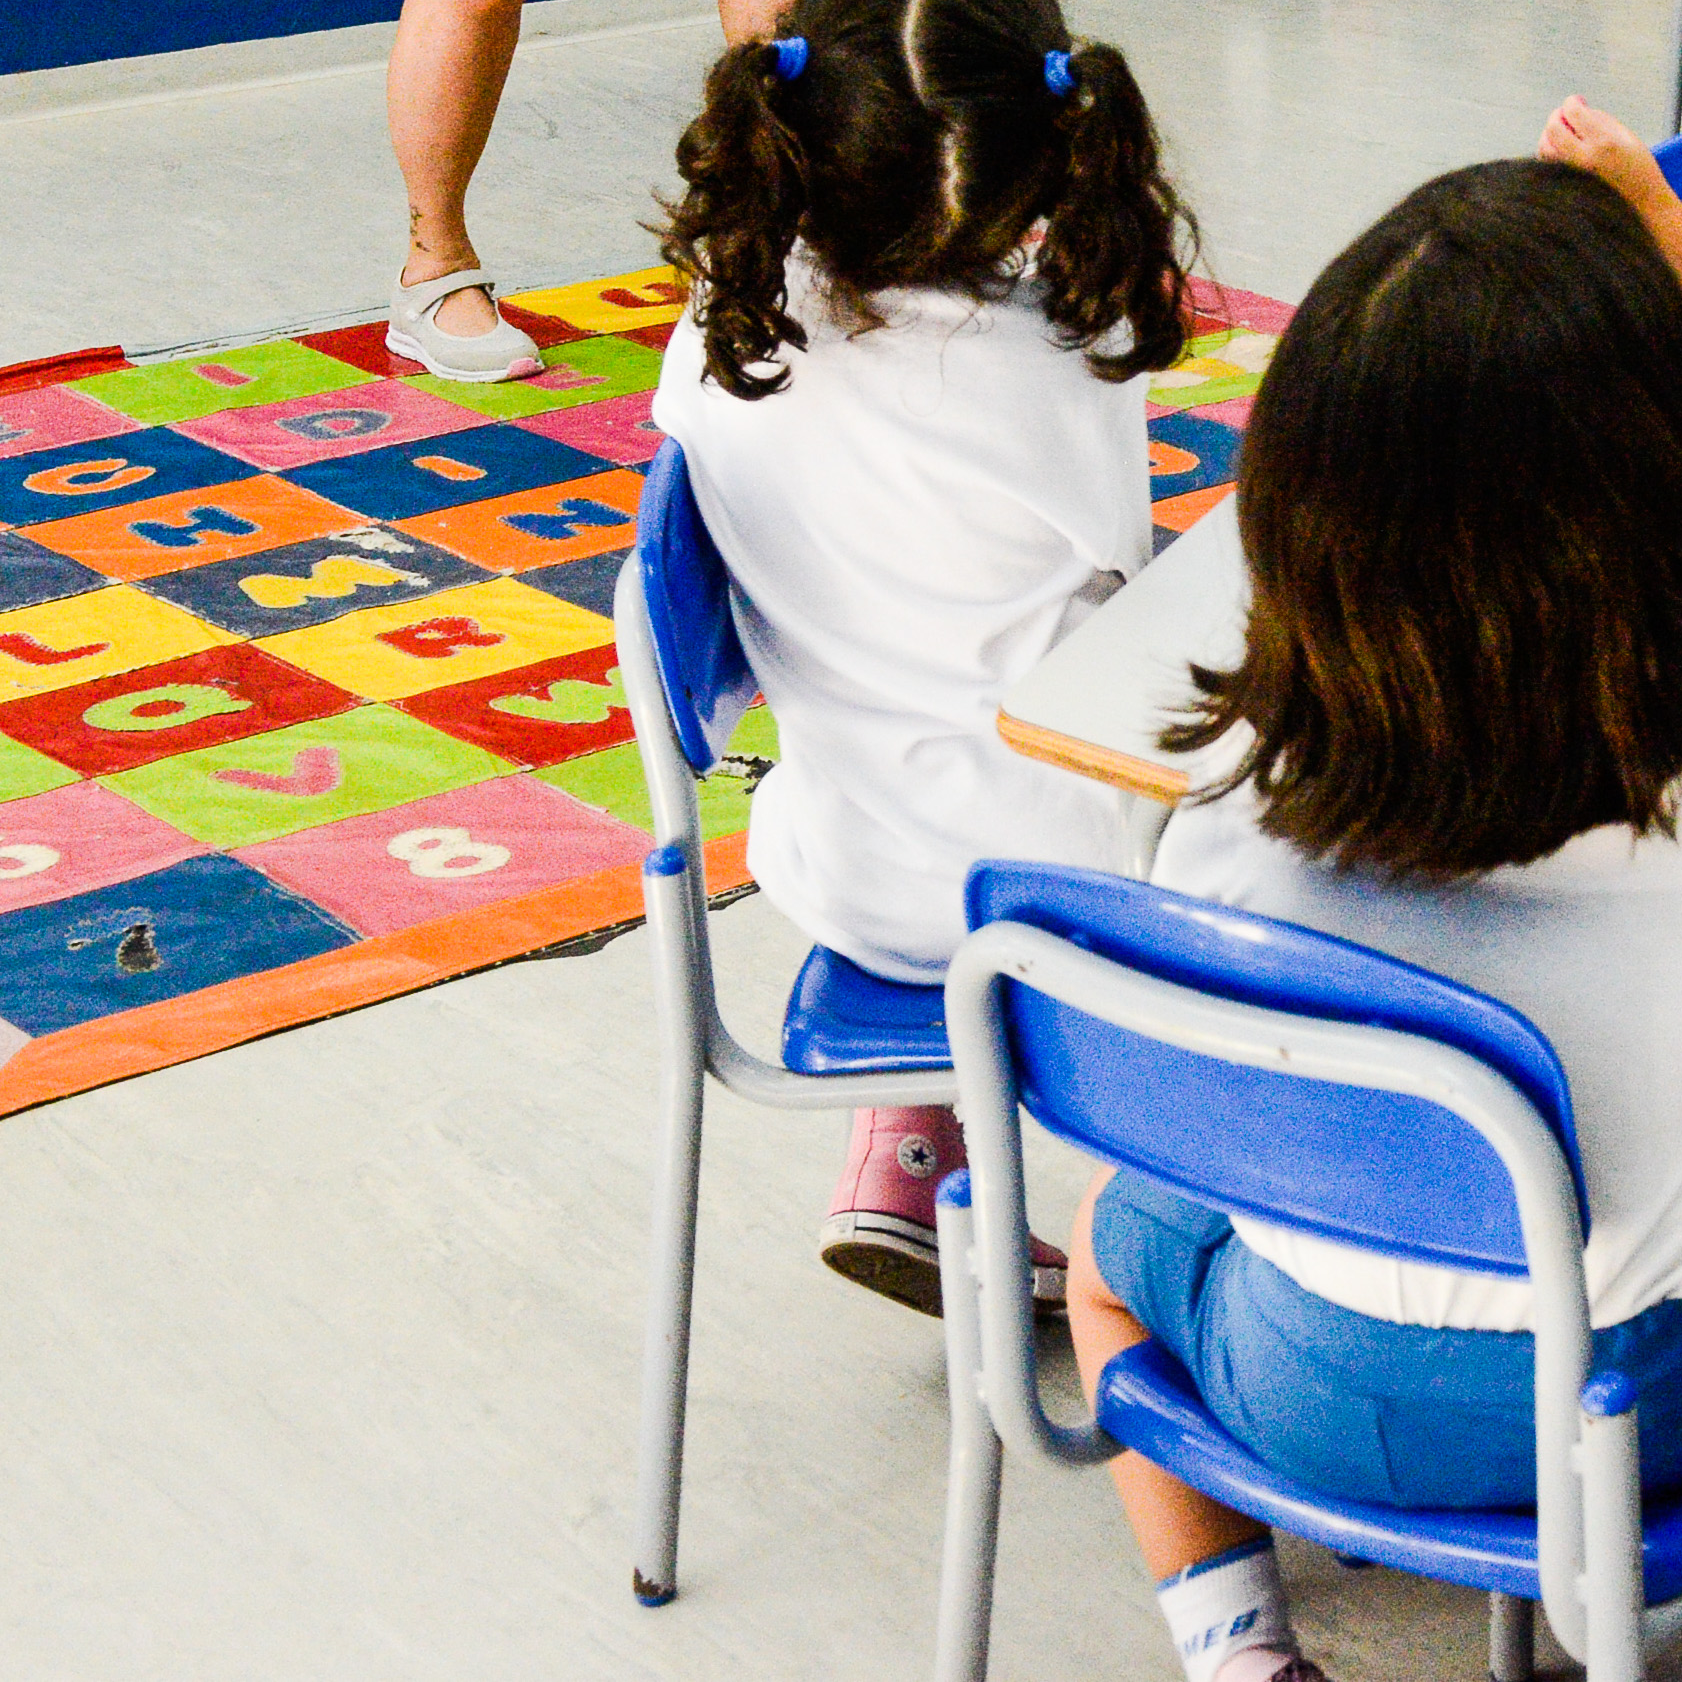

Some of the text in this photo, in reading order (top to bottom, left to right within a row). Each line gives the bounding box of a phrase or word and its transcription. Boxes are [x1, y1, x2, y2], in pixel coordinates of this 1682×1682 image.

[275, 408, 395, 442] D
[22, 457, 156, 496] C
[127, 505, 261, 548] H
[237, 554, 426, 610] M
[374, 615, 508, 659] R
[82, 681, 254, 732] Q
[205, 744, 343, 798] V
[386, 824, 513, 880] 8
